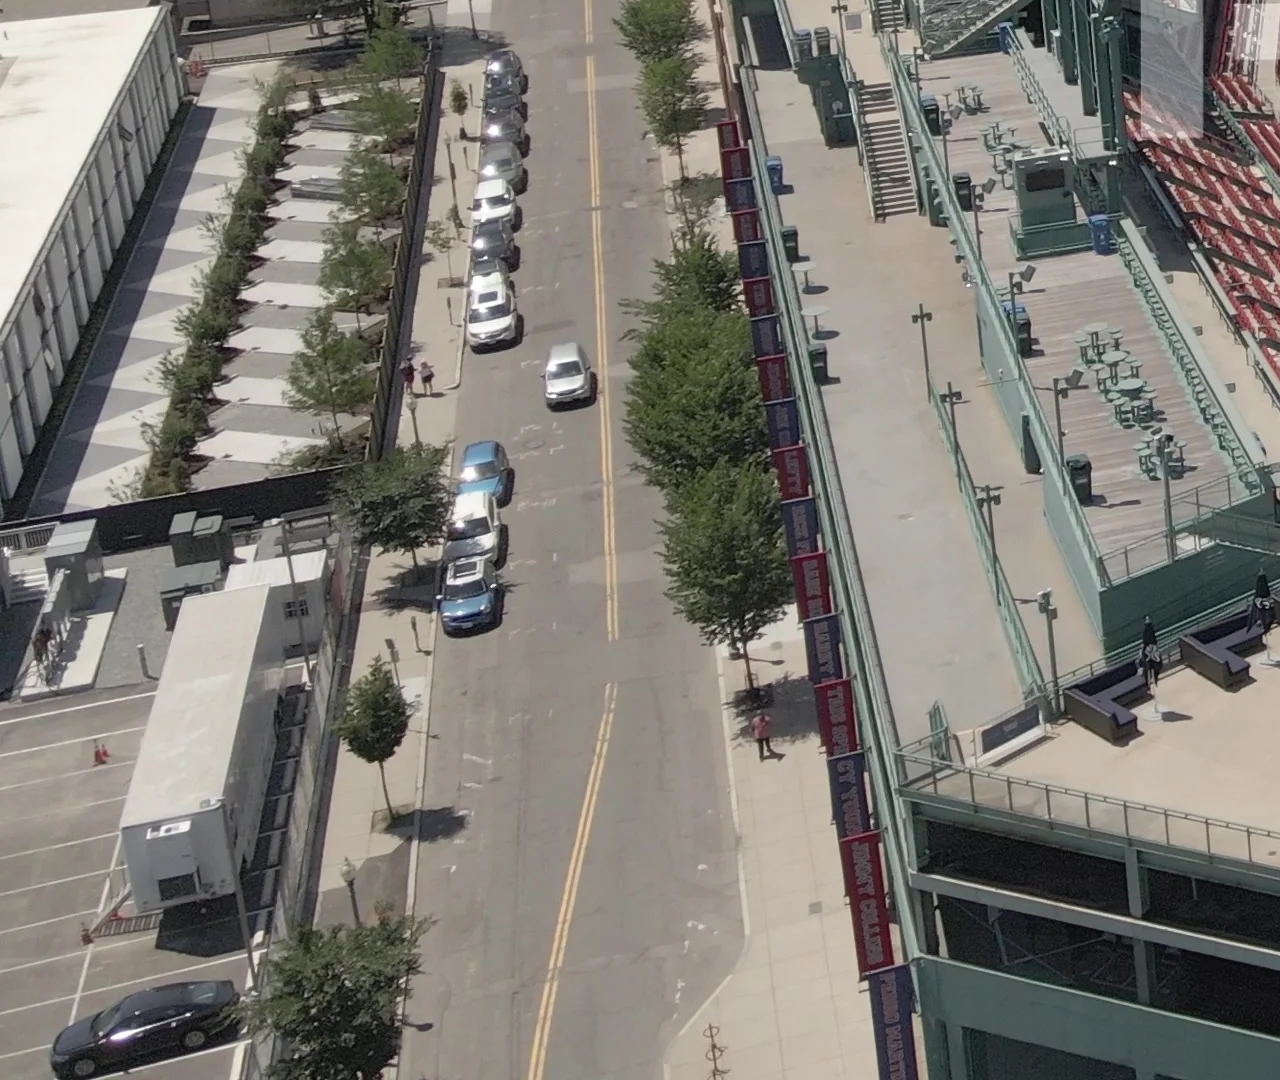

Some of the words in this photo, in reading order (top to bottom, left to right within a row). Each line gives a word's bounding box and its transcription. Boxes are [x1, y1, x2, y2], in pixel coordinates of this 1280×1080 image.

[836, 760, 857, 784] CY
[851, 841, 876, 896] JIMMY
[859, 897, 884, 965] COLLINS
